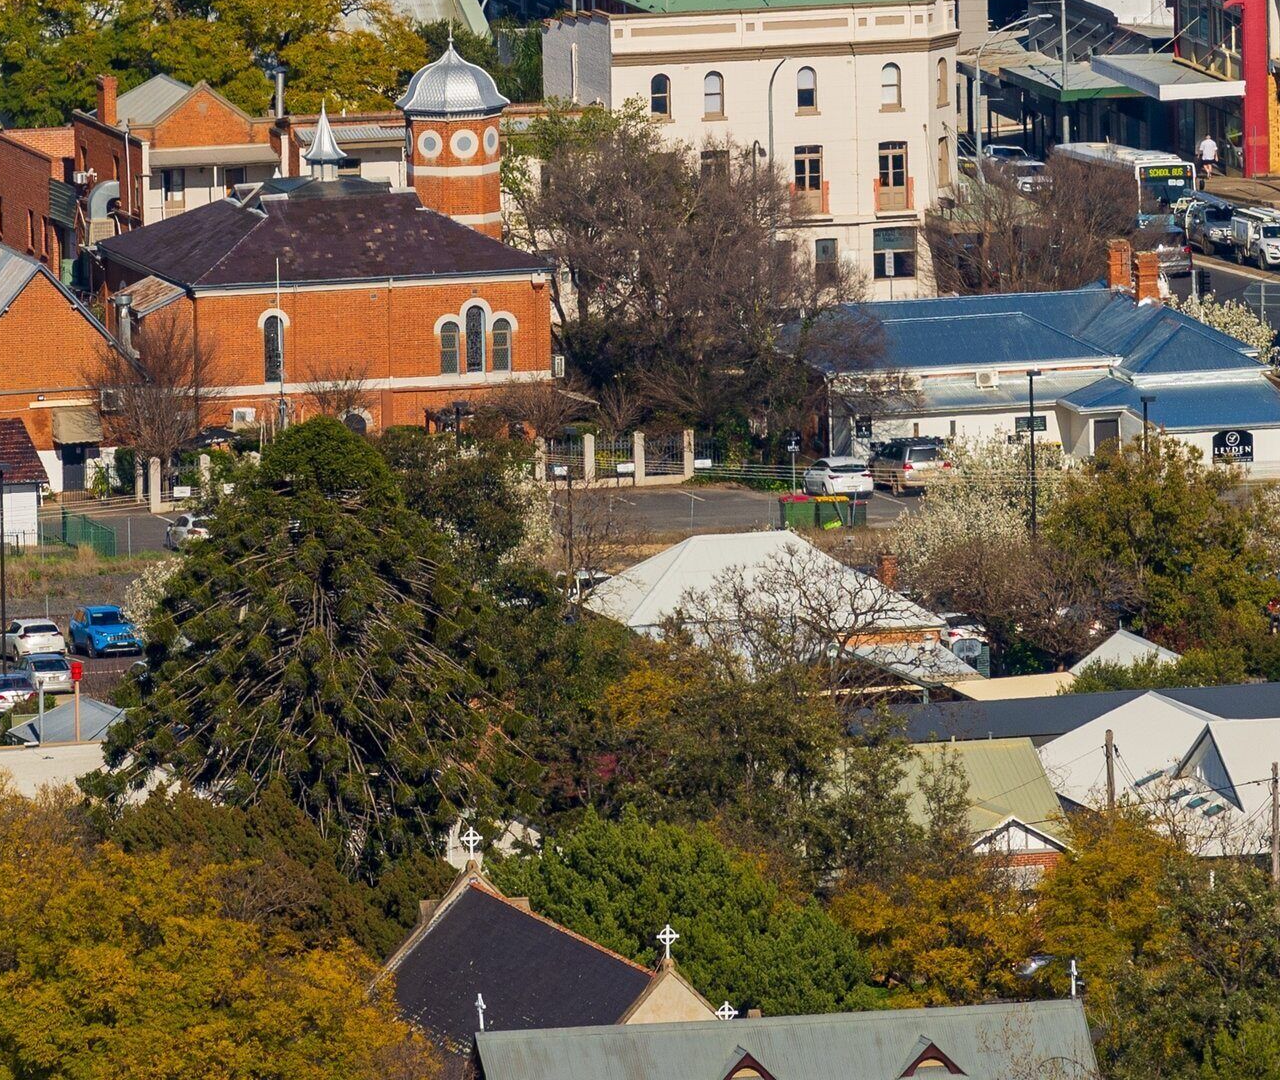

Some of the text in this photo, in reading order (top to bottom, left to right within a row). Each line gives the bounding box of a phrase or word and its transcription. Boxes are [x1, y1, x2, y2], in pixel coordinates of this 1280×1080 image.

[1149, 167, 1183, 177] SCHOOL BUS
[1214, 445, 1252, 455] LEYDEN
